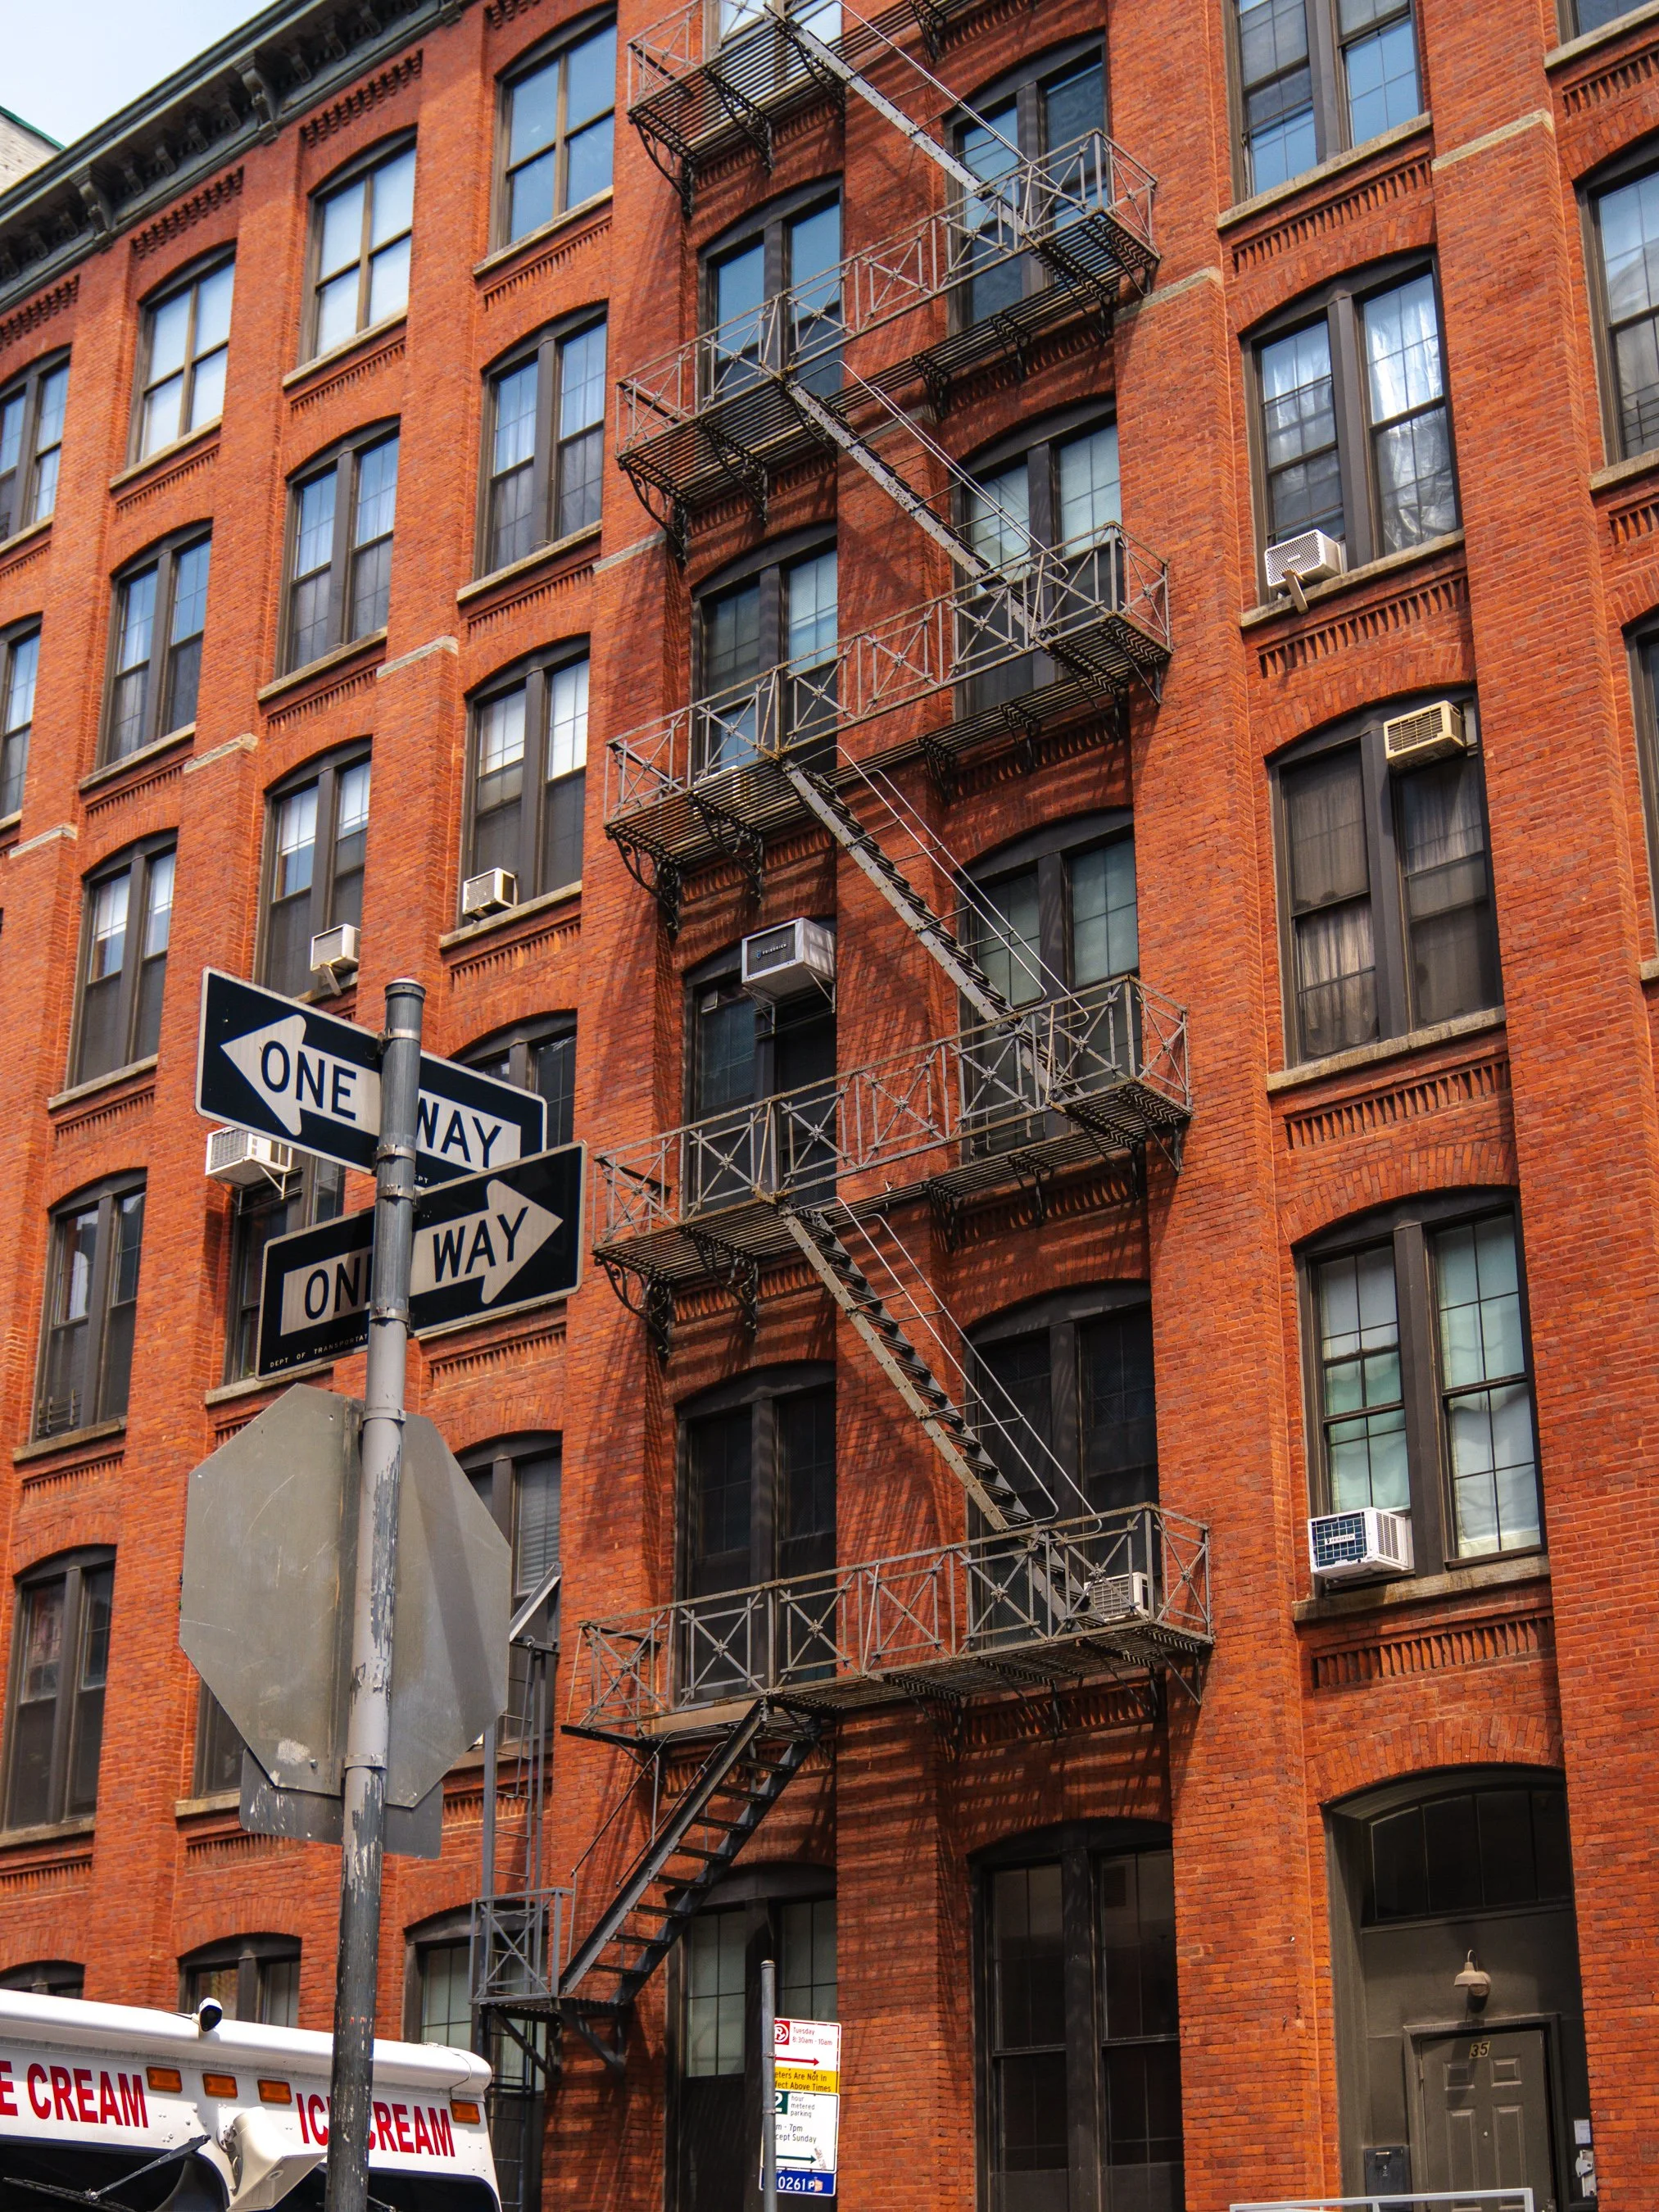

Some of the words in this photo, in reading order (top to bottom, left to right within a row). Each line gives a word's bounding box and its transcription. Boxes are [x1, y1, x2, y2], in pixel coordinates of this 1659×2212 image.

[261, 1040, 357, 1122] ONE
[417, 1097, 502, 1169] WAY
[433, 1206, 529, 1284] WAY
[270, 1357, 288, 1368] DEPT
[296, 1352, 306, 1360] OF
[314, 1333, 368, 1354] TRANSPORTAT
[793, 2027, 814, 2035] Tuesday
[792, 2036, 814, 2044] 8:30am
[1471, 2042, 1489, 2057] 35
[774, 2071, 792, 2079] eters
[794, 2072, 805, 2080] Are
[807, 2073, 818, 2082] Not
[775, 2080, 788, 2089] fect
[791, 2082, 810, 2090] Above
[813, 2083, 832, 2092] Times
[27, 2062, 149, 2128] CREAM
[791, 2094, 805, 2102] hour
[296, 2092, 330, 2146] IC
[791, 2110, 812, 2119] parking
[789, 2124, 803, 2133] 7pm
[776, 2133, 791, 2142] cept
[792, 2133, 817, 2144] Sunday
[778, 2176, 806, 2192] 0261
